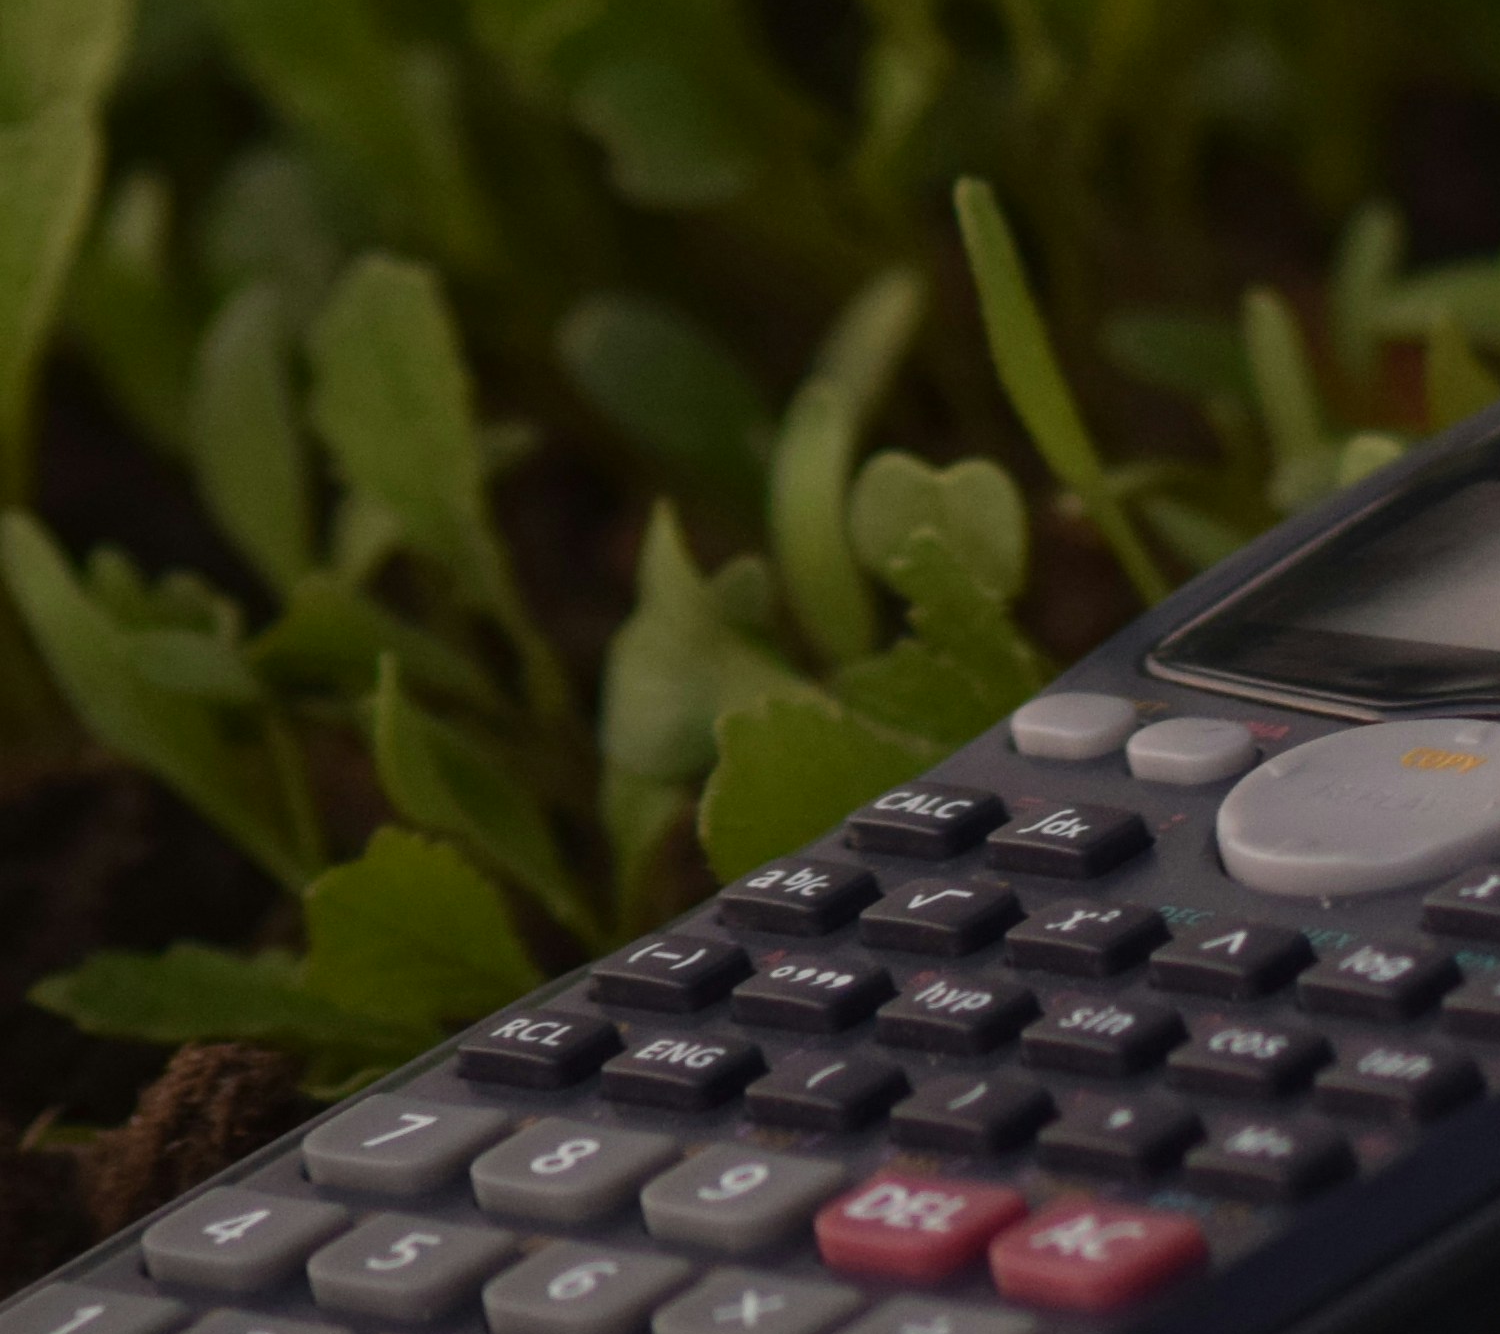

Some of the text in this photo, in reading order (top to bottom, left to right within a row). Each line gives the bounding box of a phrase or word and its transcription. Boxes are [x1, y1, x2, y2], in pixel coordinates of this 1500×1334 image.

[1401, 747, 1489, 775] COPY
[873, 789, 975, 821] CALC
[1336, 944, 1415, 982] log
[912, 980, 993, 1014] hyp
[489, 1017, 574, 1047] RCL
[1057, 1003, 1137, 1037] sin
[633, 1039, 728, 1069] ENG
[1206, 1028, 1290, 1059] cos
[360, 1112, 442, 1151] 7
[529, 1135, 602, 1177] 8
[696, 1159, 771, 1203] 9
[201, 1206, 273, 1246] 4
[843, 1182, 967, 1234] DEL
[364, 1229, 444, 1273] 5
[545, 1257, 620, 1302] 6
